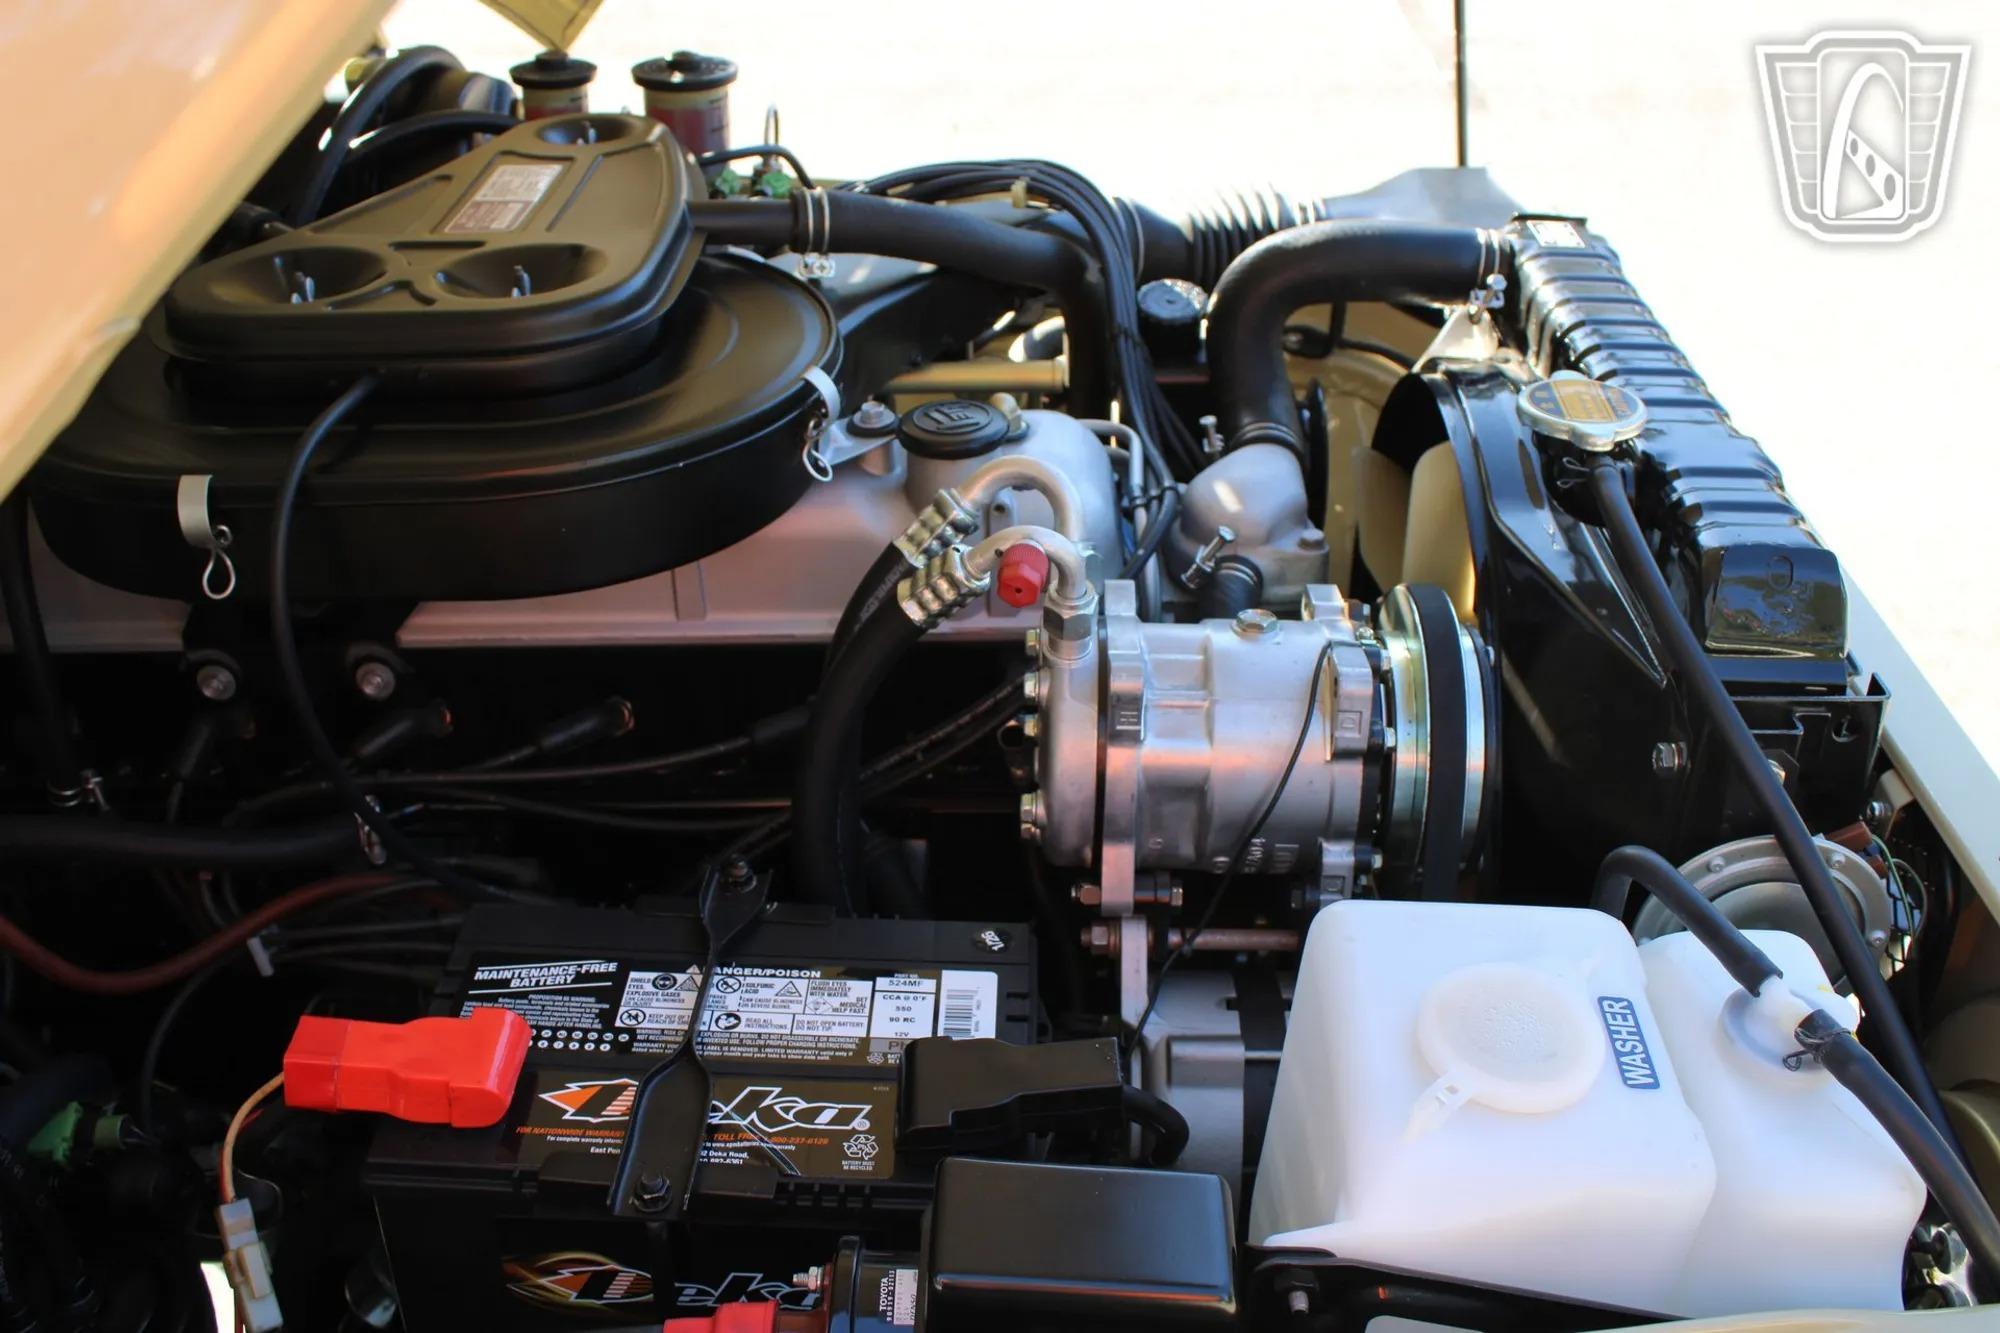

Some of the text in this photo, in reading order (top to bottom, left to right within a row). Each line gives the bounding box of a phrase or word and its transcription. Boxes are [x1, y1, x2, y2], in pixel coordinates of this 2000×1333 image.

[474, 962, 619, 981] MAINTENANCE-FREE
[712, 966, 821, 978] ANGER/POISON
[509, 974, 576, 988] BATTERY
[1602, 999, 1655, 1085] WASHER
[713, 1132, 736, 1140] TOLL
[590, 1146, 607, 1154] East
[880, 1277, 889, 1312] TOYOTA
